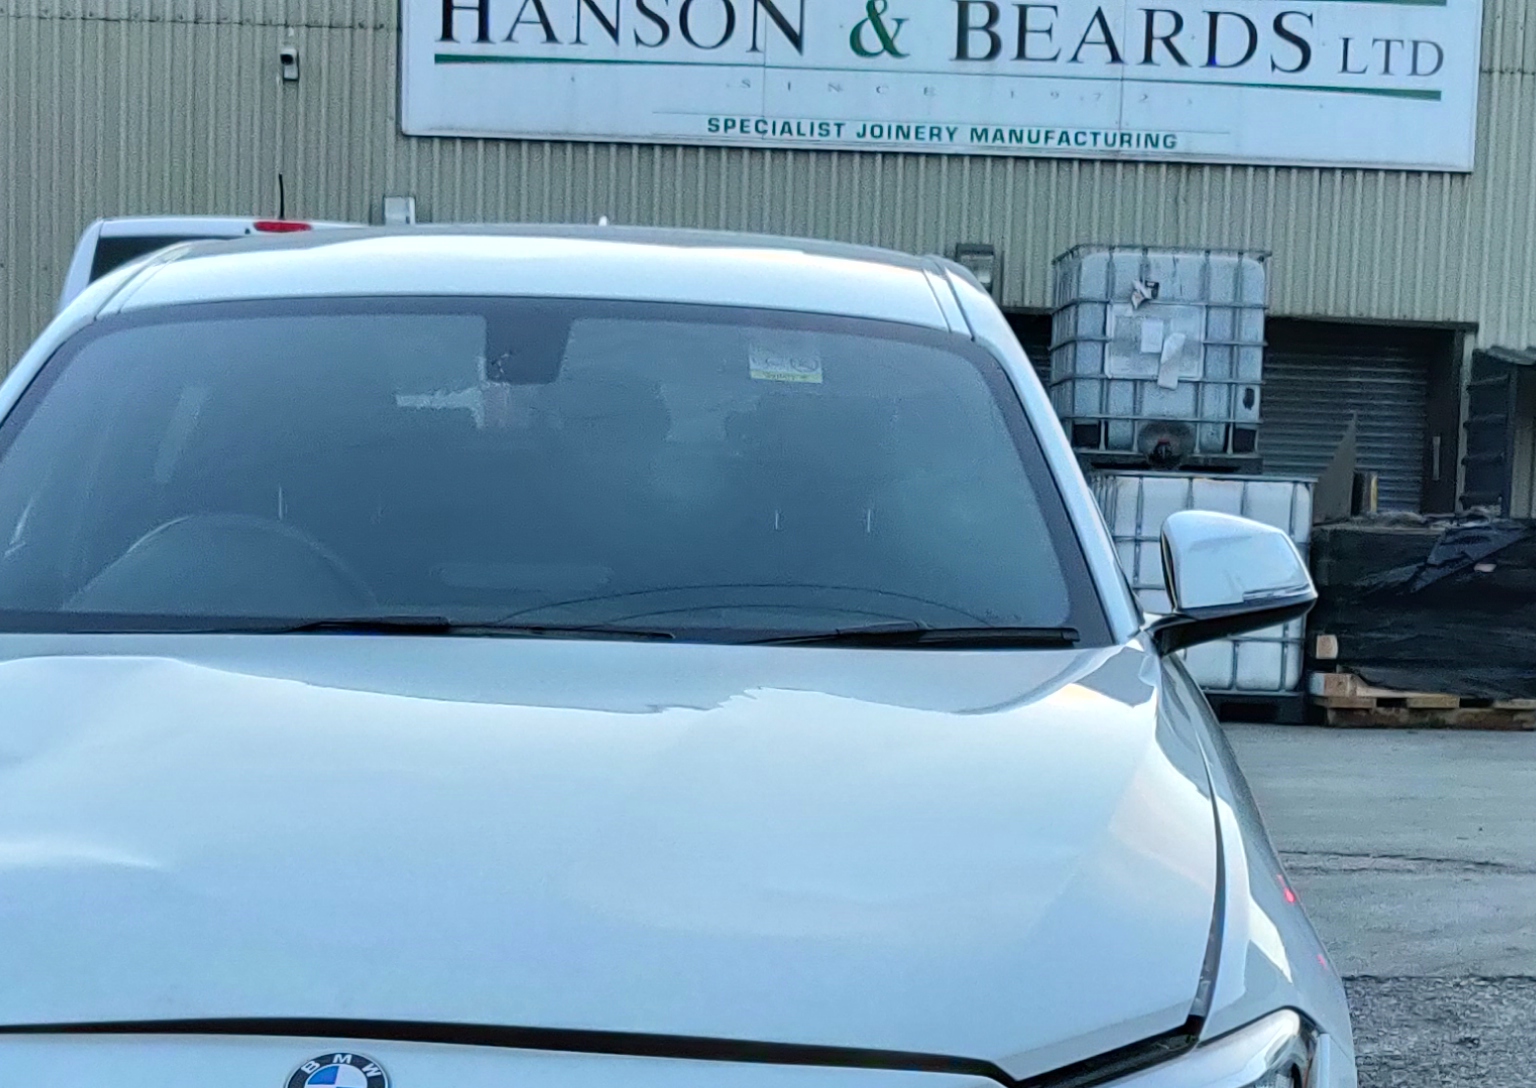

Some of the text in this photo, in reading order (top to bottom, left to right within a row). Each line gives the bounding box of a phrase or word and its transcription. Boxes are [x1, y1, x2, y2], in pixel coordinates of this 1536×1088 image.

[435, 0, 1445, 77] HANSON & BEARDS LTD
[706, 116, 1178, 150] SPECIALIST JOINERY MANUFACTURING
[300, 1053, 382, 1078] BMW
